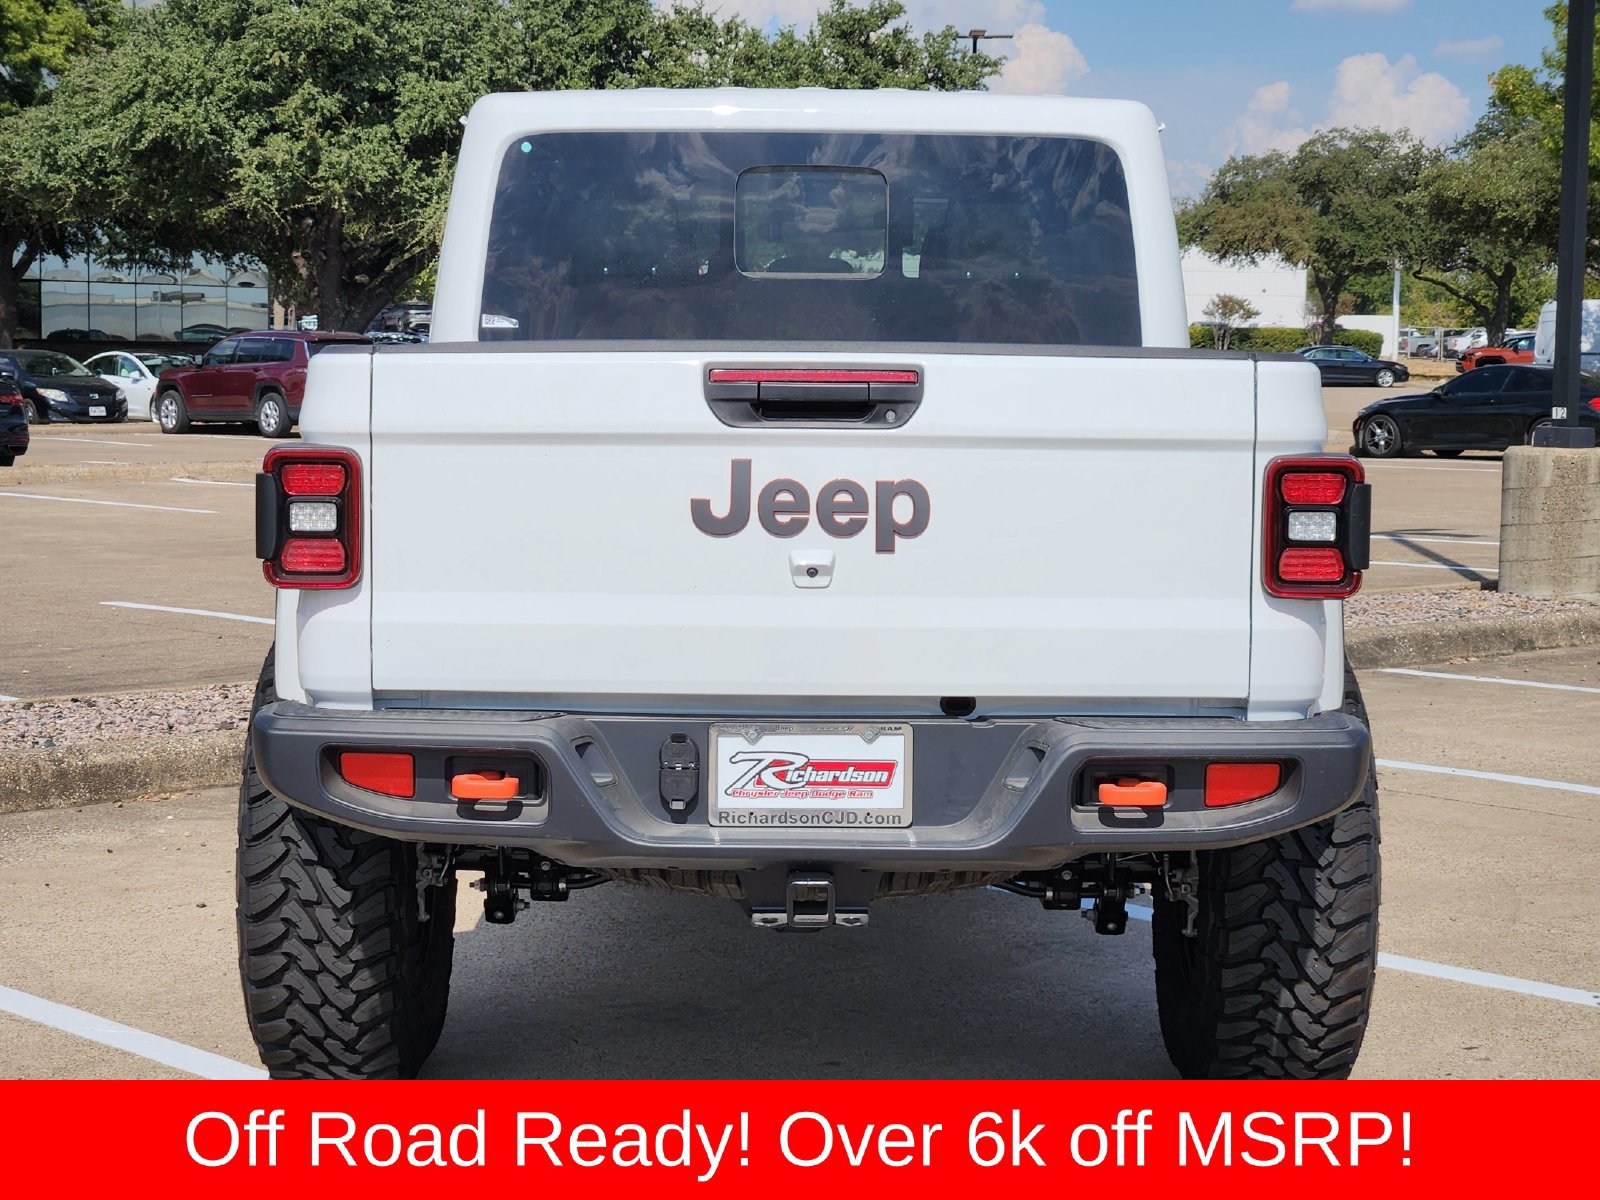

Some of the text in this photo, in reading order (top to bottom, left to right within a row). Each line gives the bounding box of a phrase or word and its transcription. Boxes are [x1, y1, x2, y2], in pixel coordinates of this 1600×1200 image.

[690, 458, 931, 554] Jeep
[725, 751, 889, 796] Richardson
[731, 788, 873, 799] Chrysler Jeep Dodge Ram
[718, 811, 902, 825] RichardsonCJD.com
